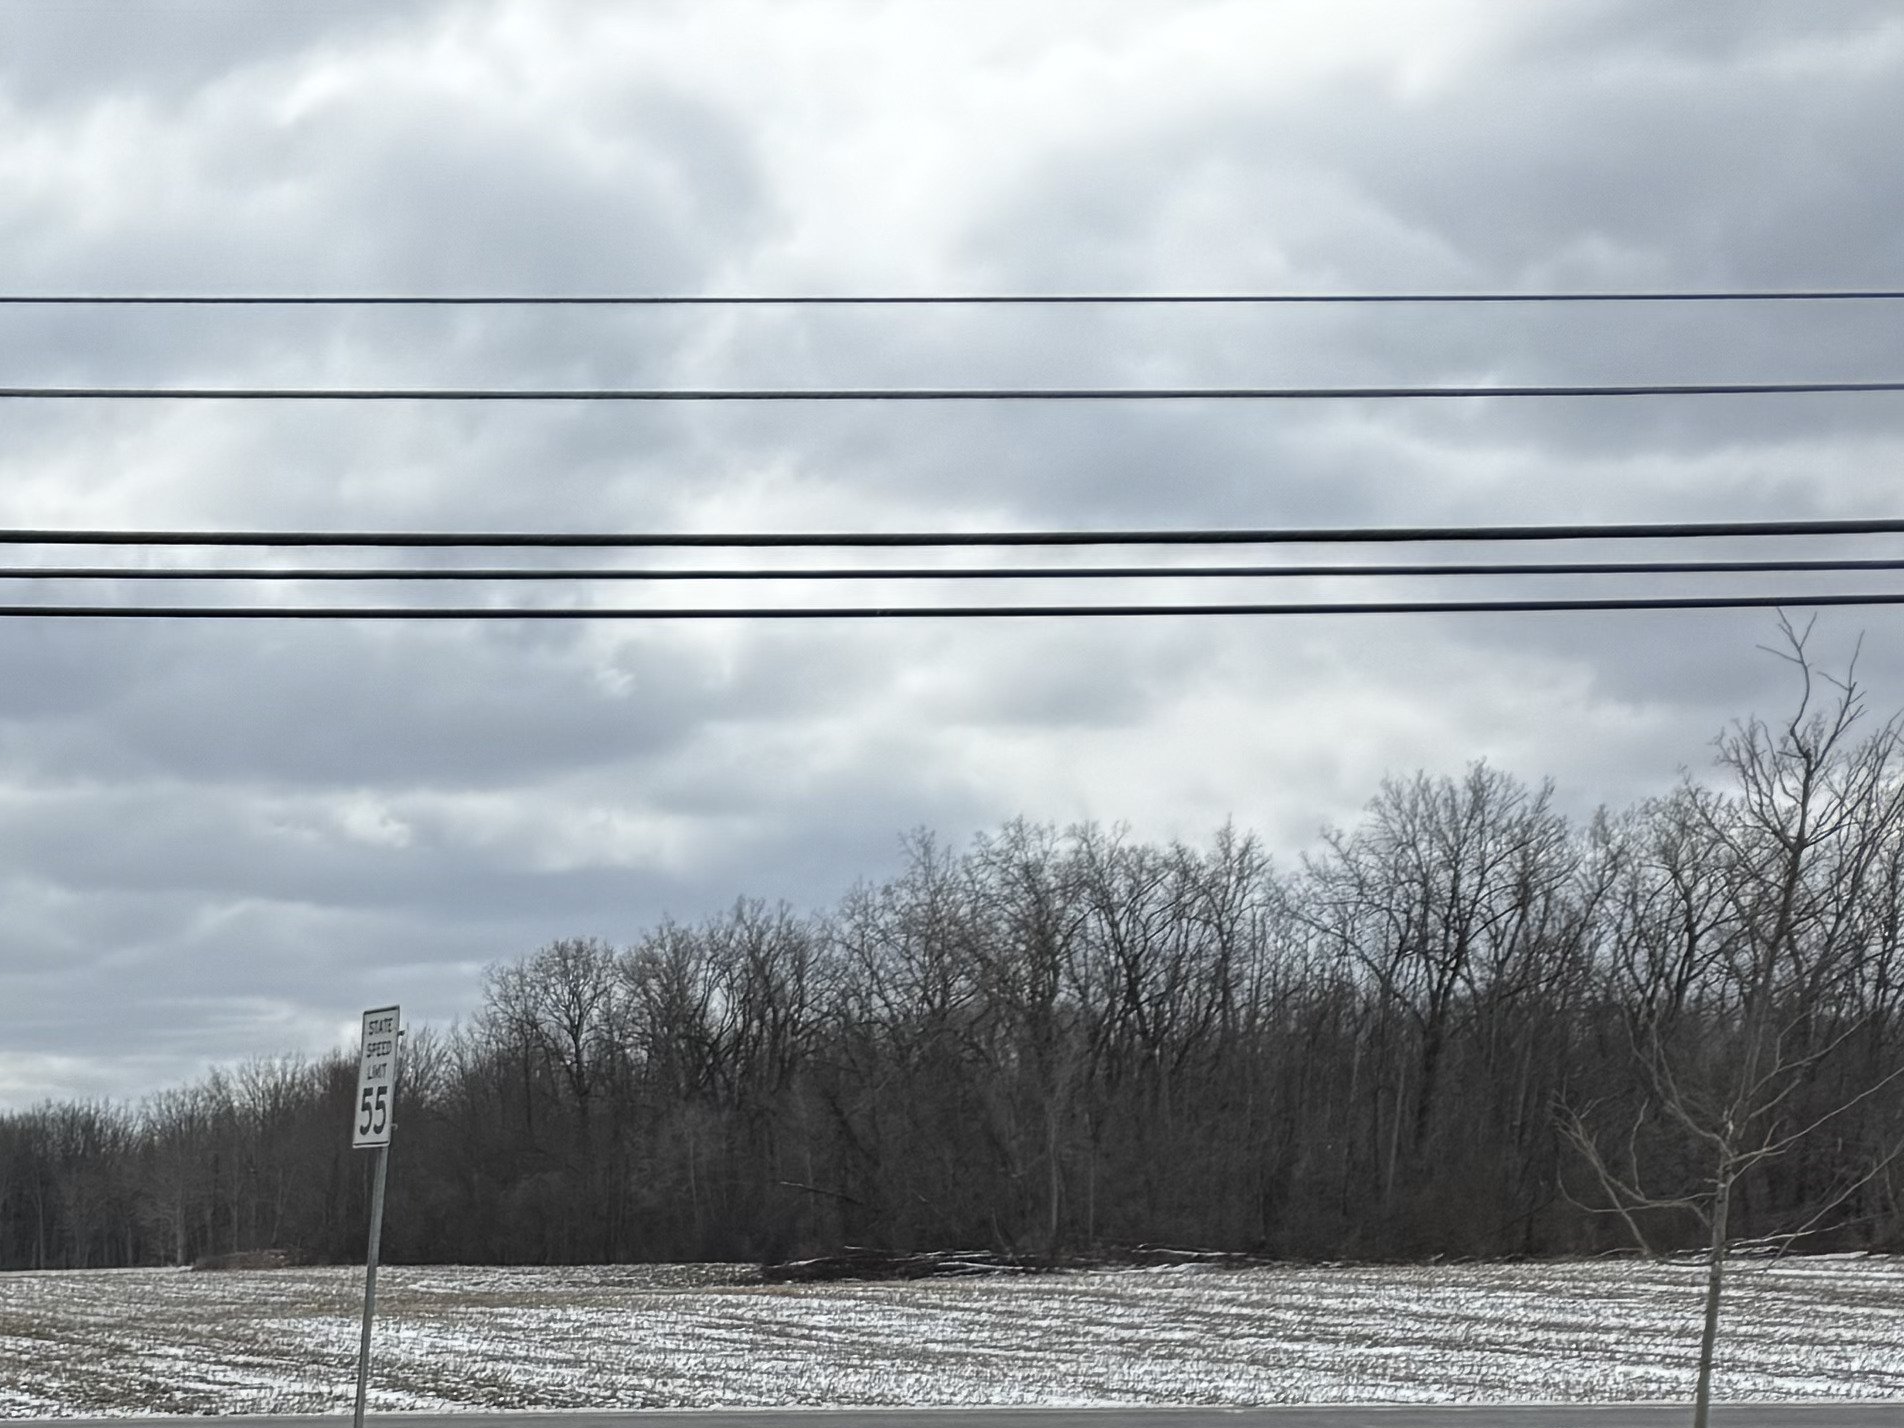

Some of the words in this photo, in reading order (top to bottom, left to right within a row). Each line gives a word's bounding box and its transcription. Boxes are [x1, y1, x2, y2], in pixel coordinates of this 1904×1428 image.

[368, 1017, 394, 1036] STATE
[366, 1040, 393, 1058] SPEED
[367, 1062, 388, 1080] LIMIT
[359, 1085, 389, 1136] 55
